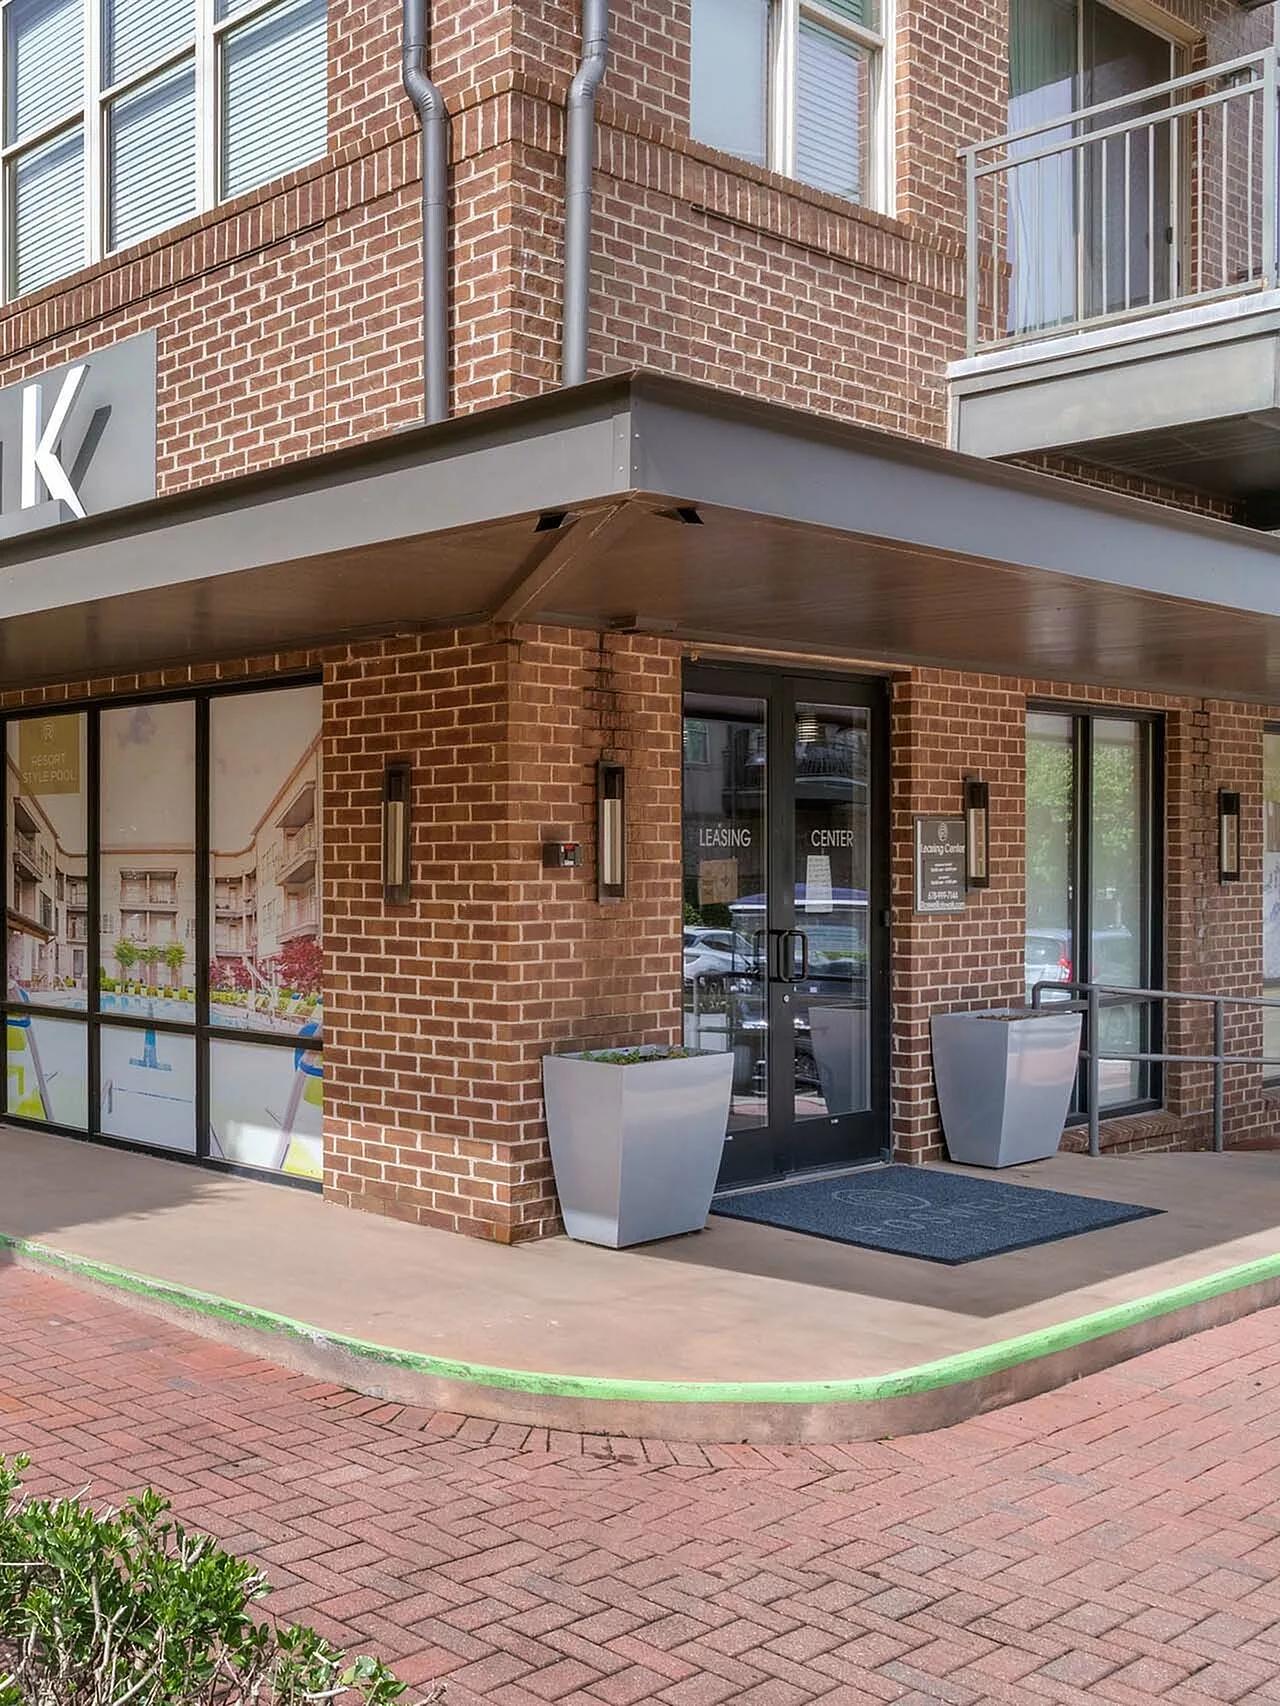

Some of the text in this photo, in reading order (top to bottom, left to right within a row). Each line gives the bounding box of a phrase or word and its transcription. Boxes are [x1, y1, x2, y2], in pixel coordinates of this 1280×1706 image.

[22, 769, 76, 784] STYLE POOL
[699, 828, 854, 848] LEASING CENTER
[920, 843, 965, 856] Leasing Center
